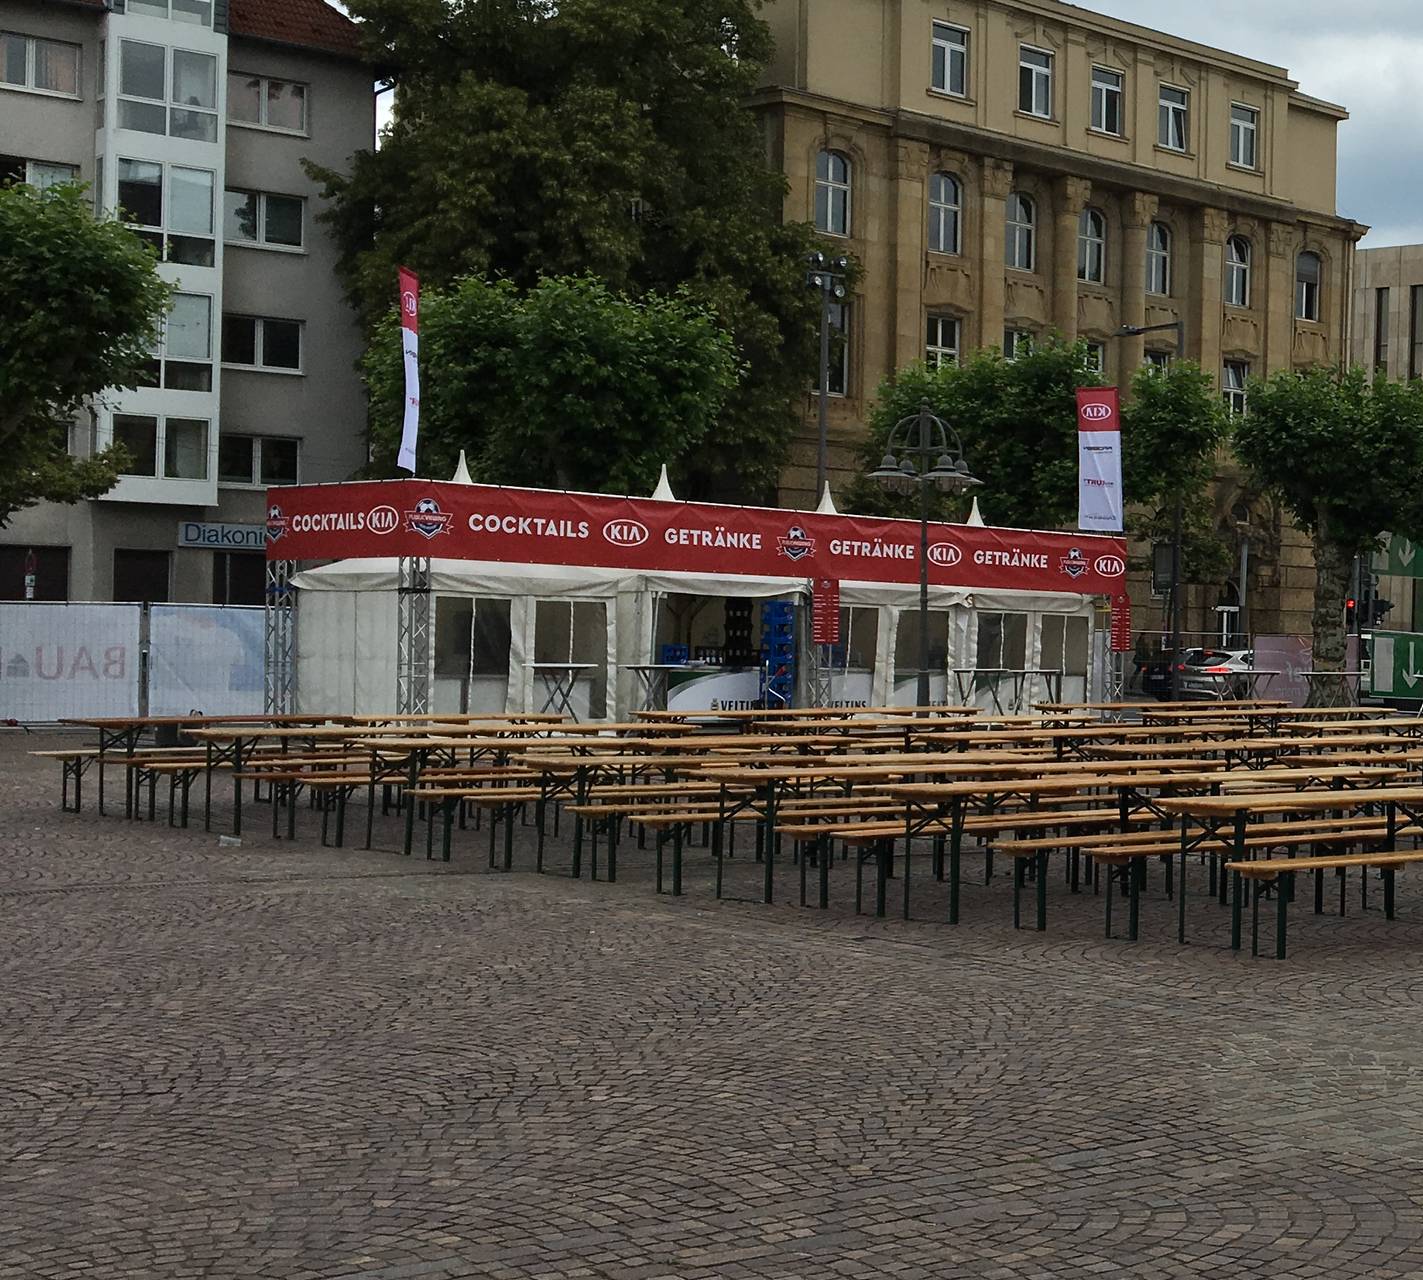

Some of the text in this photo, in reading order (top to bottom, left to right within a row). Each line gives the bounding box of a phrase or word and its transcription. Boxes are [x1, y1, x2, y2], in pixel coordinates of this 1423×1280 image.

[293, 512, 394, 532] COCKTAILS KIA
[468, 513, 762, 549] COCKTAILS KIA GETRÄNKE
[829, 538, 1048, 568] GETRÄNKE KIA GETRÄNKE
[1099, 560, 1120, 573] KIA
